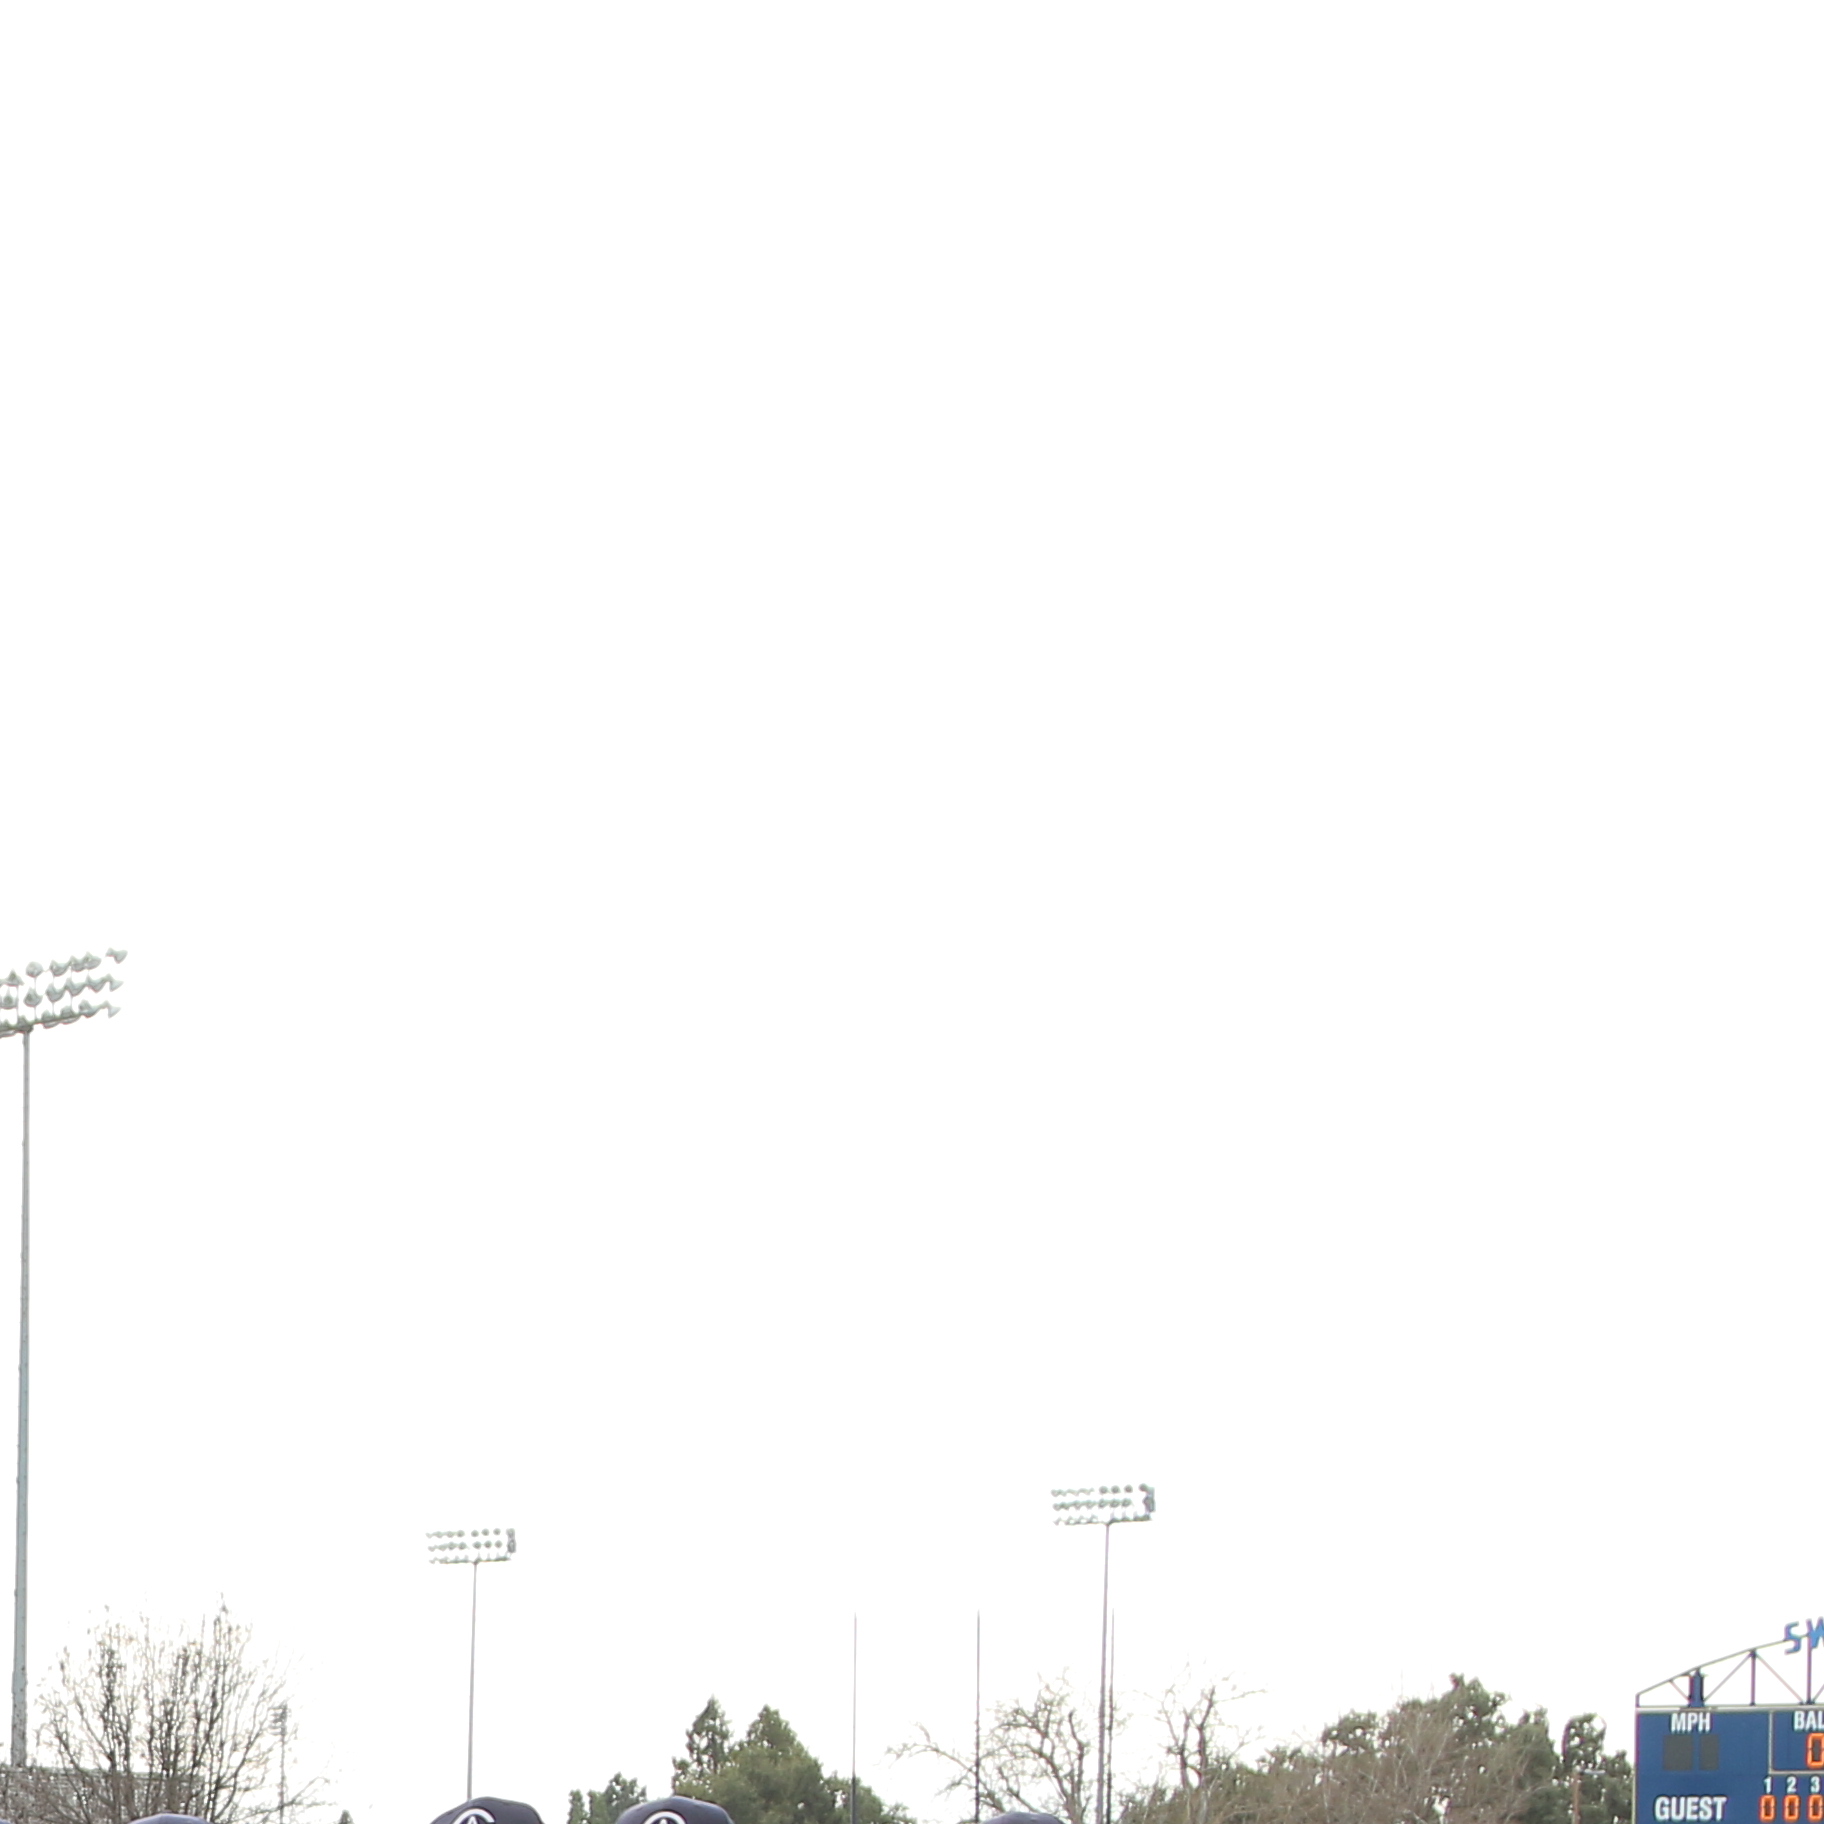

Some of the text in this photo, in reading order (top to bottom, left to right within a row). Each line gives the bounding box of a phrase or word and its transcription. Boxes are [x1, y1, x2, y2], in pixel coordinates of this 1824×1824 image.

[1671, 1713, 1711, 1732] MPH
[1763, 1776, 1820, 1793] 1 2 3
[1655, 1796, 1727, 1822] GUEST
